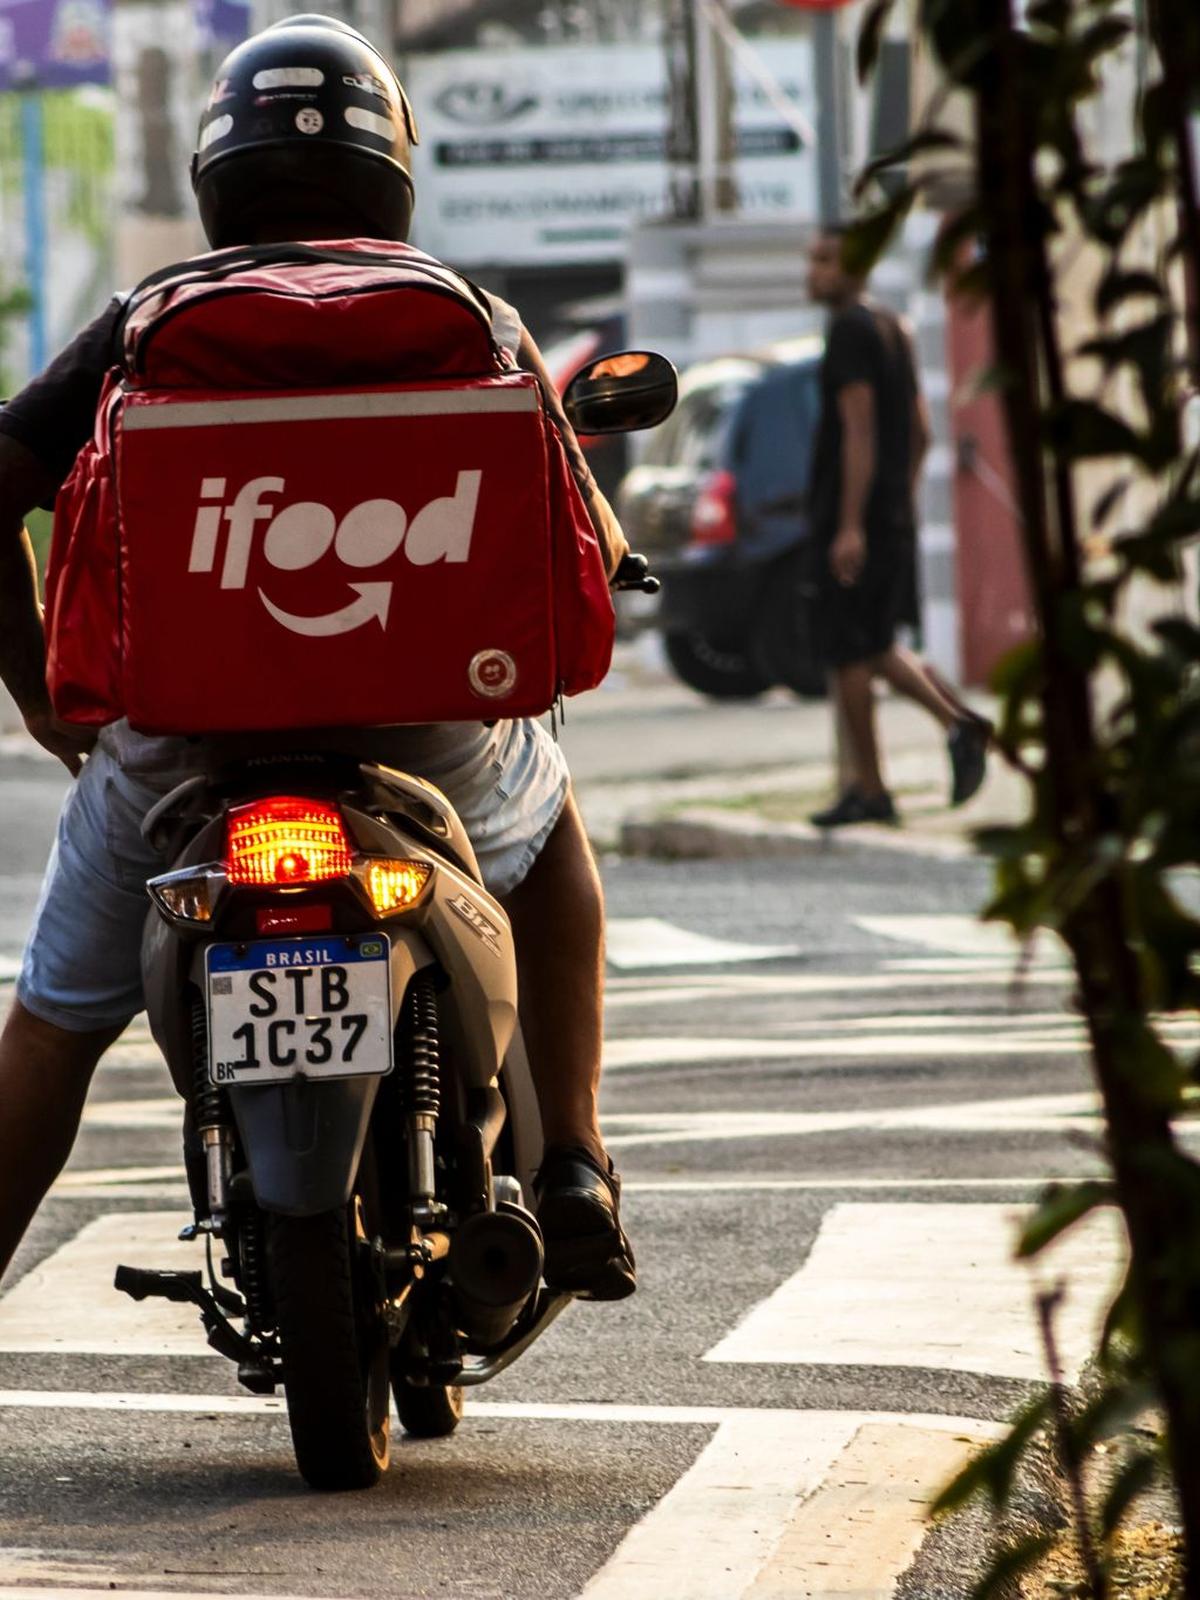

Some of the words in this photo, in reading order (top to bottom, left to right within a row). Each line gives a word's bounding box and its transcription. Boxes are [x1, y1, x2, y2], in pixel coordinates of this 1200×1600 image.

[188, 469, 482, 590] ifood
[265, 949, 333, 966] BRASIL
[249, 965, 350, 1018] STB
[232, 1014, 368, 1070] 1C37
[216, 1062, 236, 1080] BR
